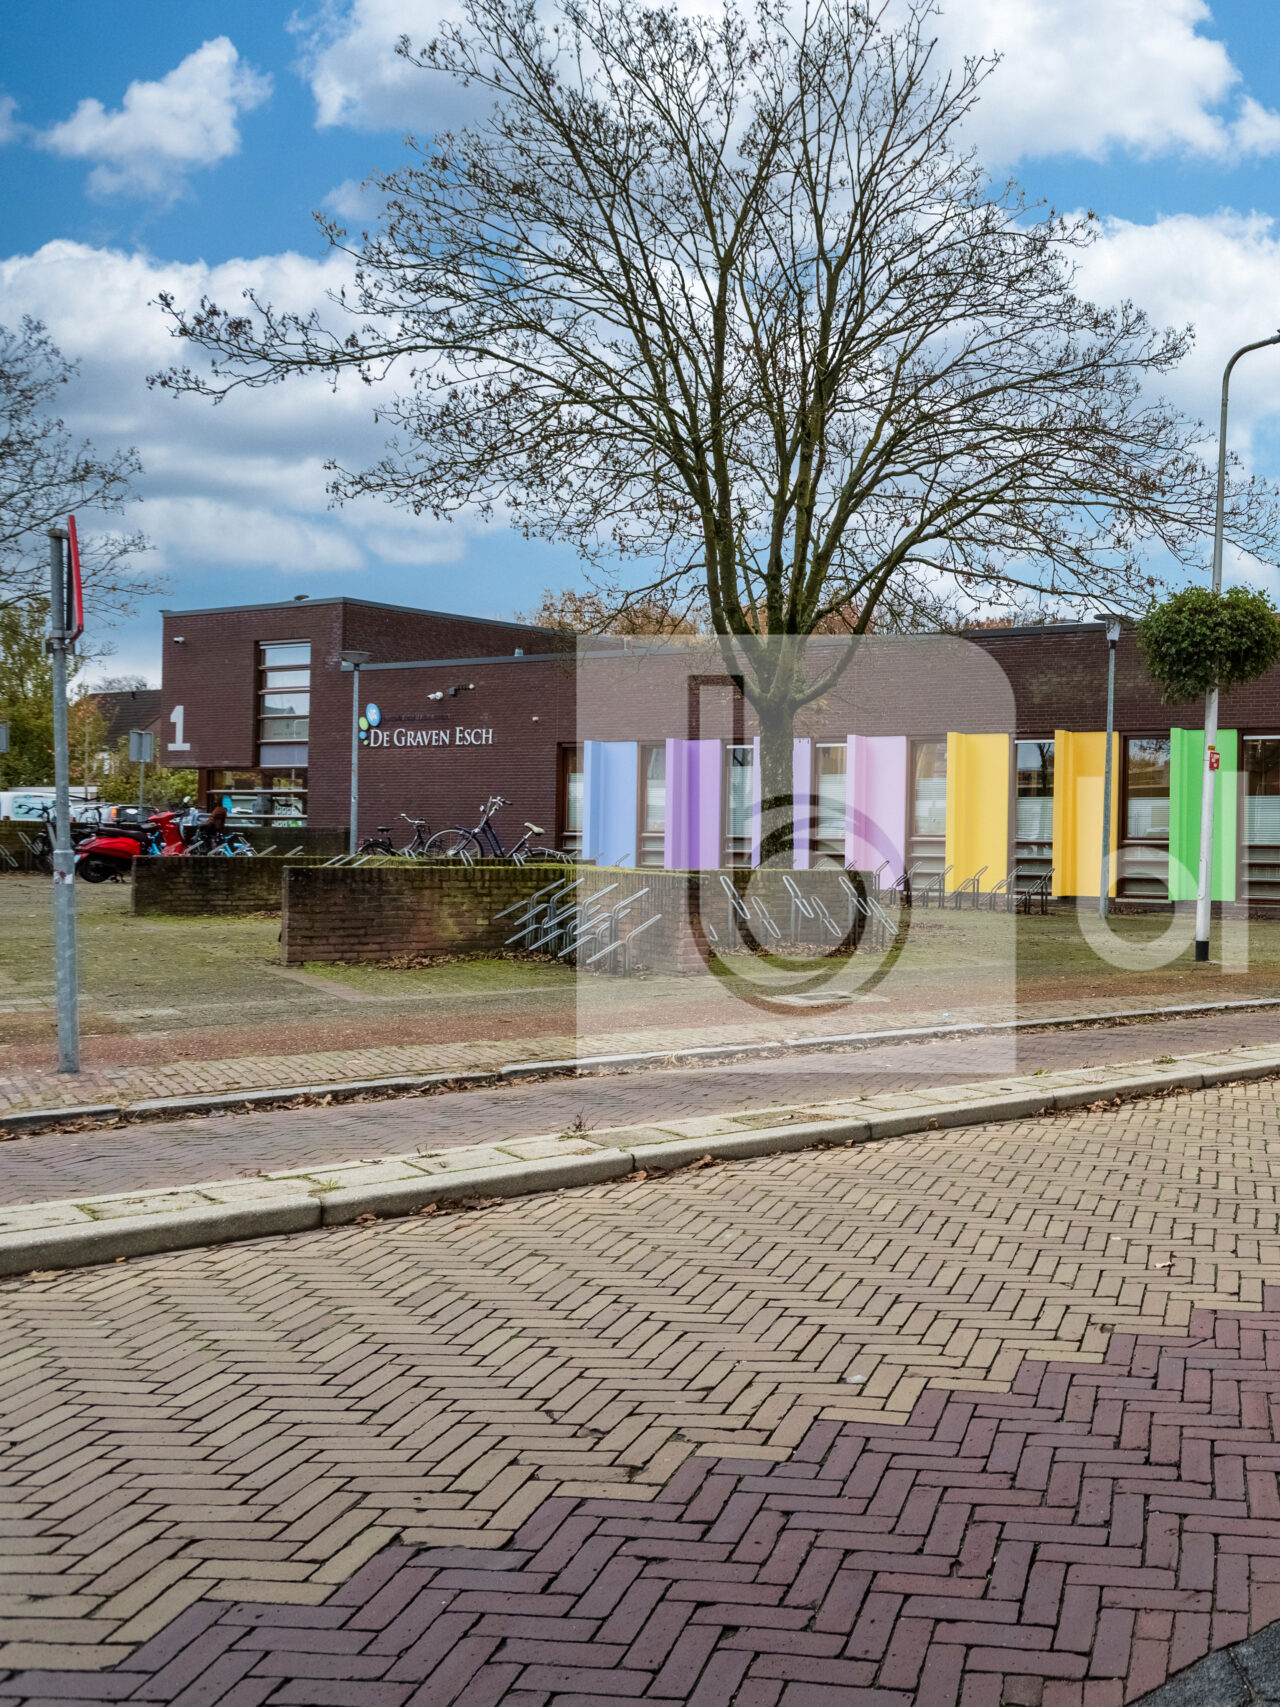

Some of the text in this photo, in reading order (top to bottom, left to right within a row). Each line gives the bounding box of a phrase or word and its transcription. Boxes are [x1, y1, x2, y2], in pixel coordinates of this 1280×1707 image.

[167, 705, 191, 751] 1
[370, 726, 493, 747] DE GRAVEN ESCH
